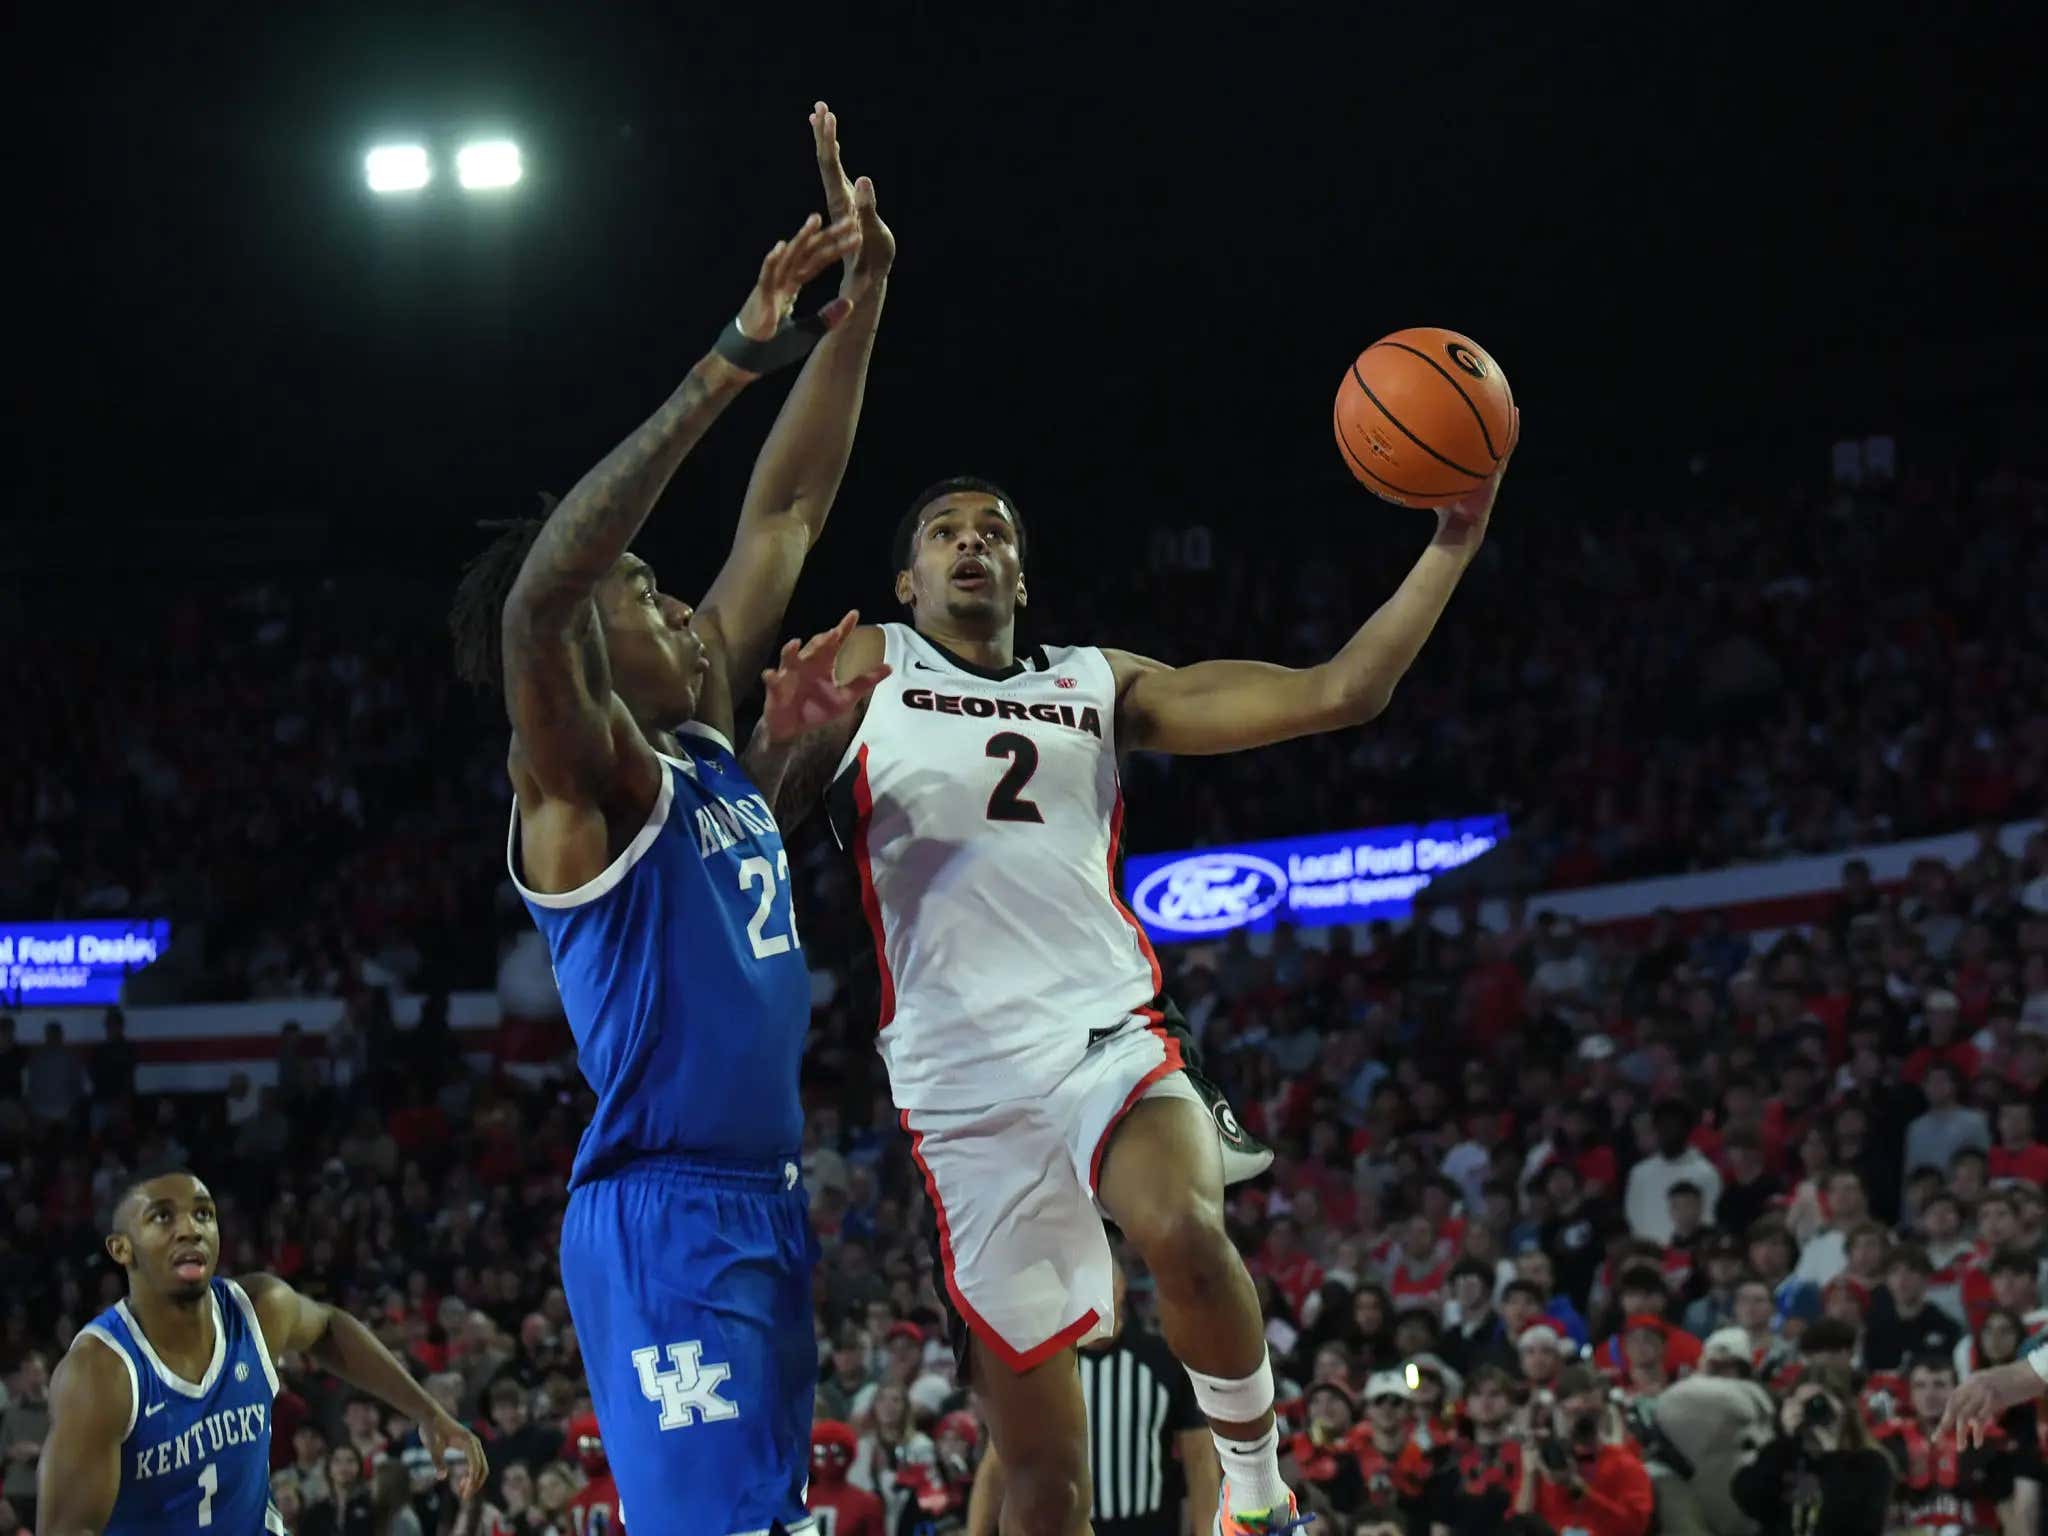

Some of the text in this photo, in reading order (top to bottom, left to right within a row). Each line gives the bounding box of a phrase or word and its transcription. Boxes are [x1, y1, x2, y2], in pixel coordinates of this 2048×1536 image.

[902, 689, 1102, 741] GEORGIA
[985, 731, 1045, 825] 2
[1355, 840, 1414, 876] Ford
[18, 935, 75, 965] Ford
[631, 1340, 740, 1431] UK
[136, 1403, 266, 1480] KENTUCKY
[197, 1462, 218, 1528] 1
